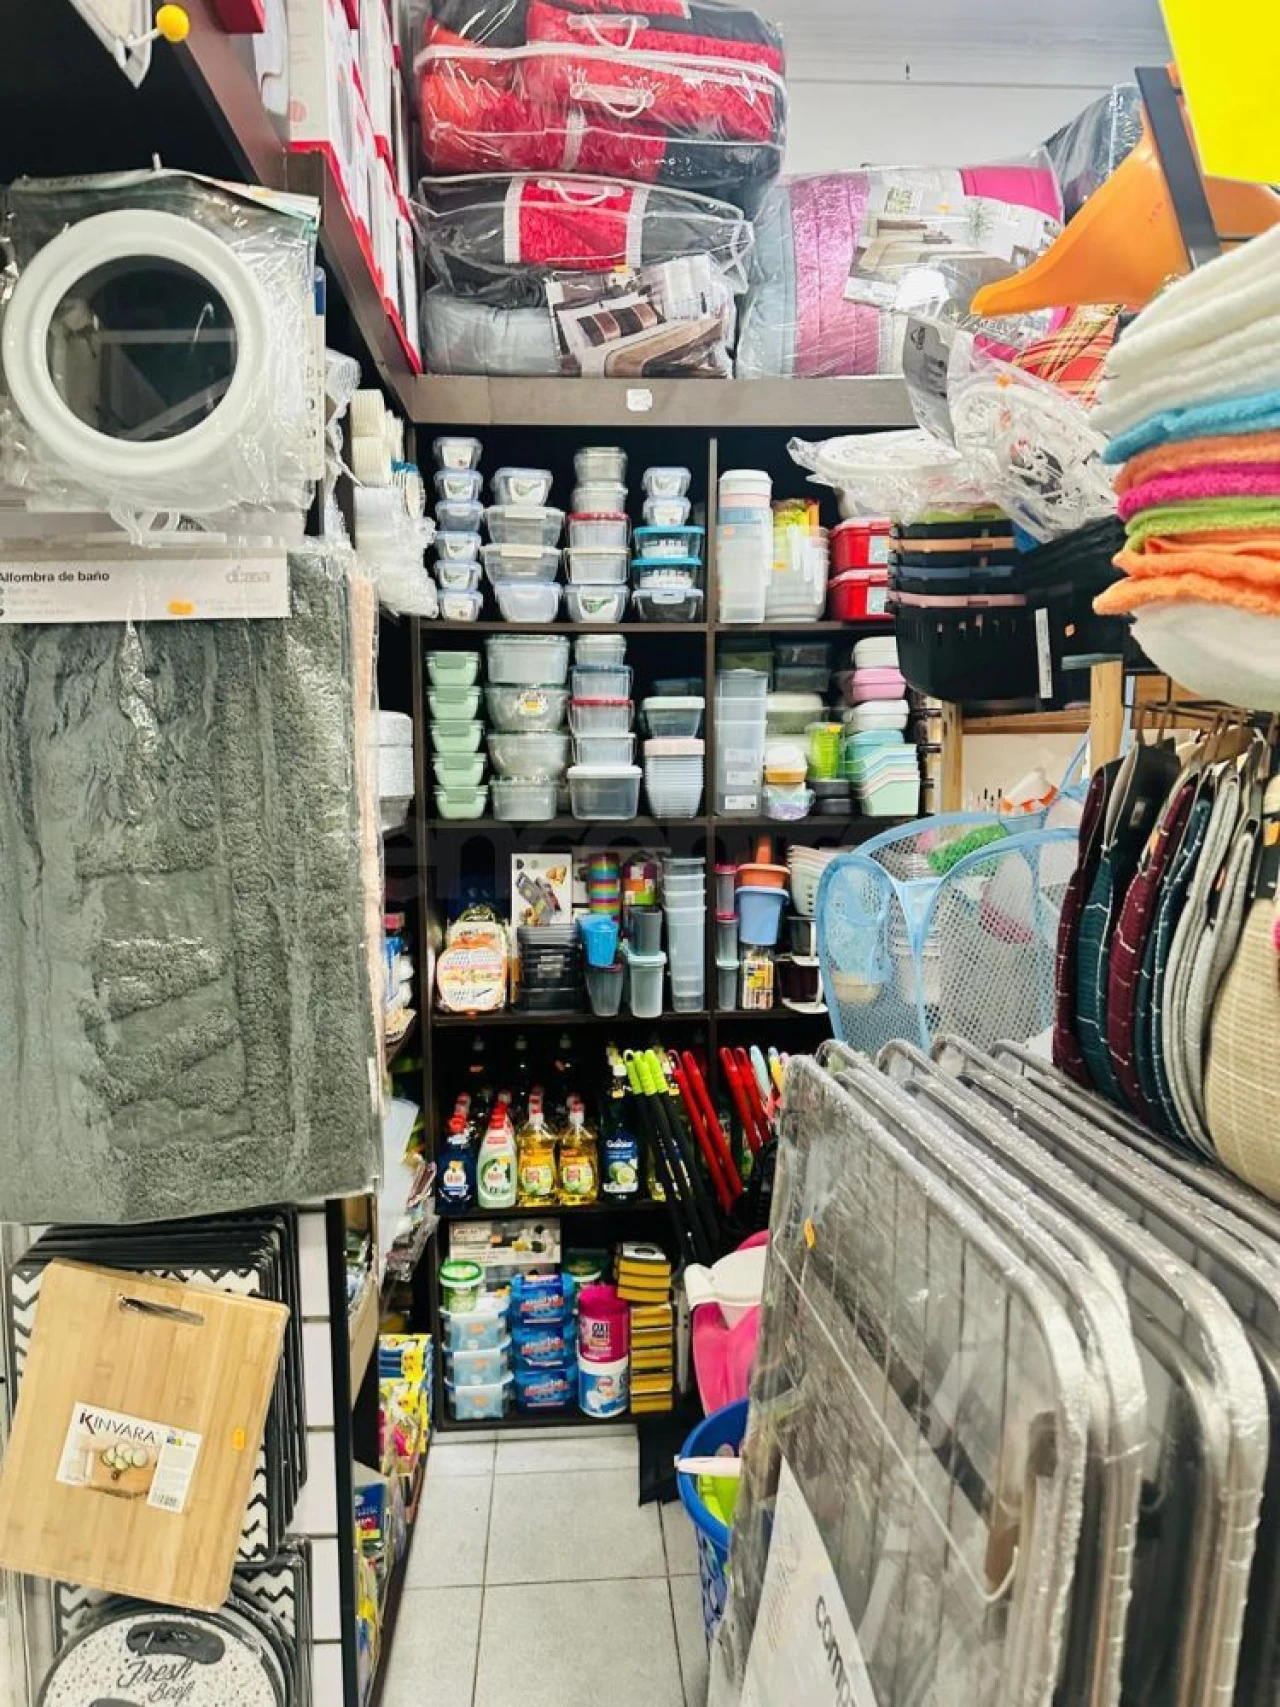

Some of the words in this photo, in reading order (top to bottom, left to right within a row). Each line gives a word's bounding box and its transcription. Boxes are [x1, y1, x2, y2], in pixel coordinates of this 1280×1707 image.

[0, 571, 55, 583] Alfombra
[58, 571, 74, 582] de
[78, 571, 110, 582] baño
[79, 1410, 157, 1444] KINVARA
[116, 1658, 193, 1689] Fresh
